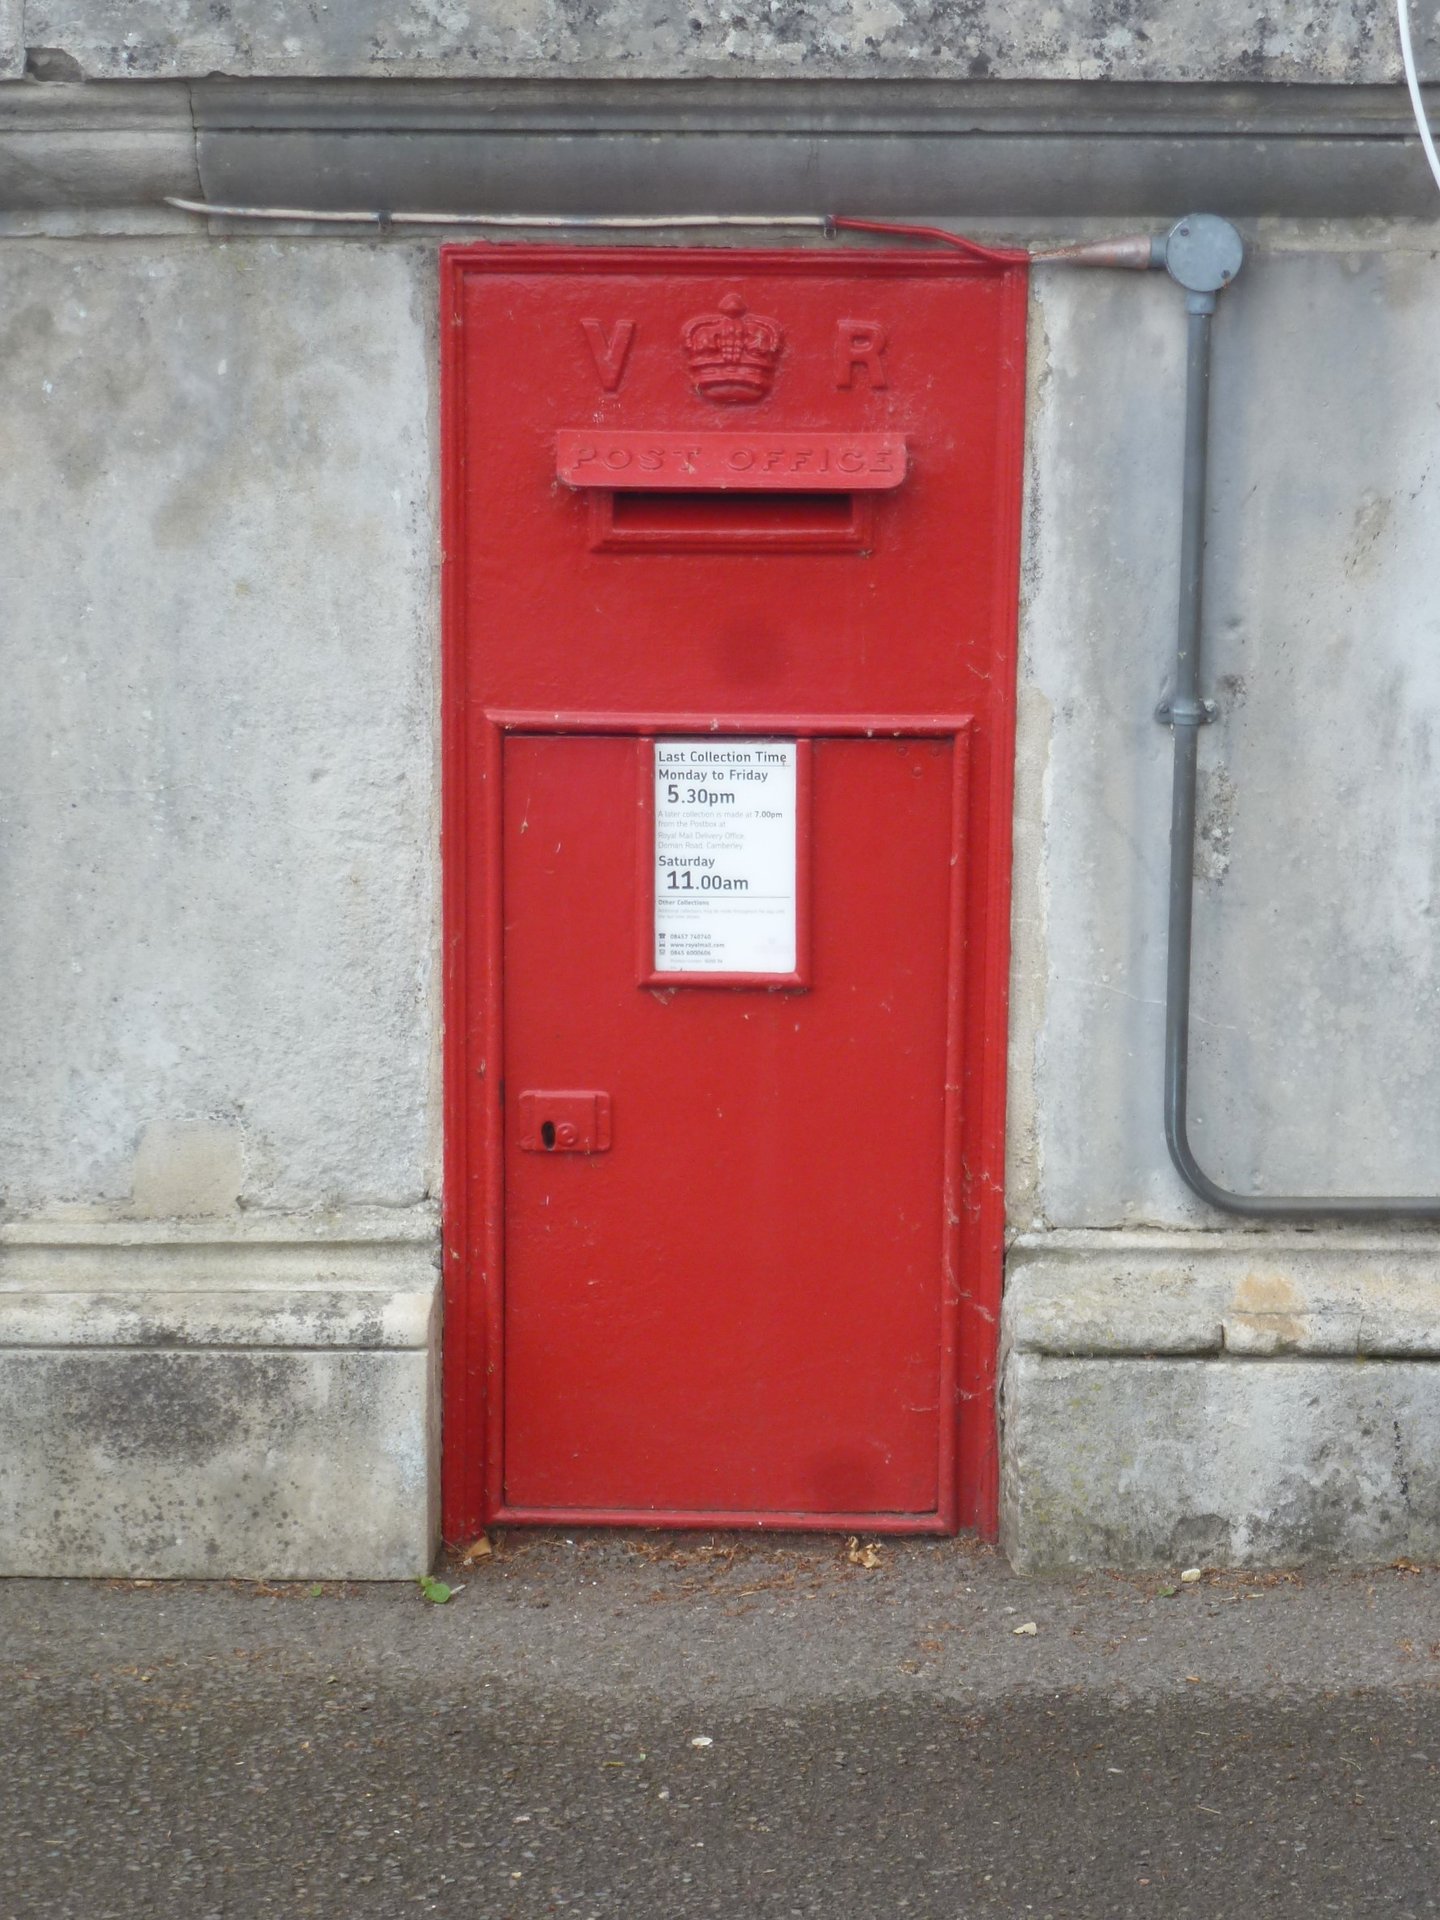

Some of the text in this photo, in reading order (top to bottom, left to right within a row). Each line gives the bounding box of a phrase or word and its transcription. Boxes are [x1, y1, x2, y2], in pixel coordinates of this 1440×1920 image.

[579, 317, 890, 394] V R
[572, 447, 895, 473] POST OFFICE
[658, 750, 788, 763] Last Collection Time
[658, 769, 769, 783] Monday to Friday
[666, 784, 736, 807] 5.30pm
[665, 810, 681, 818] later
[682, 810, 715, 818] collection
[754, 810, 783, 820] 7.00pm
[658, 820, 726, 828] from the Postbox at
[658, 832, 677, 841] Royal
[678, 832, 694, 840] Mail
[695, 832, 723, 841] Delivery
[658, 855, 715, 869] Saturday
[666, 870, 749, 891] 11.00am
[669, 942, 725, 950] www.royalmail.com
